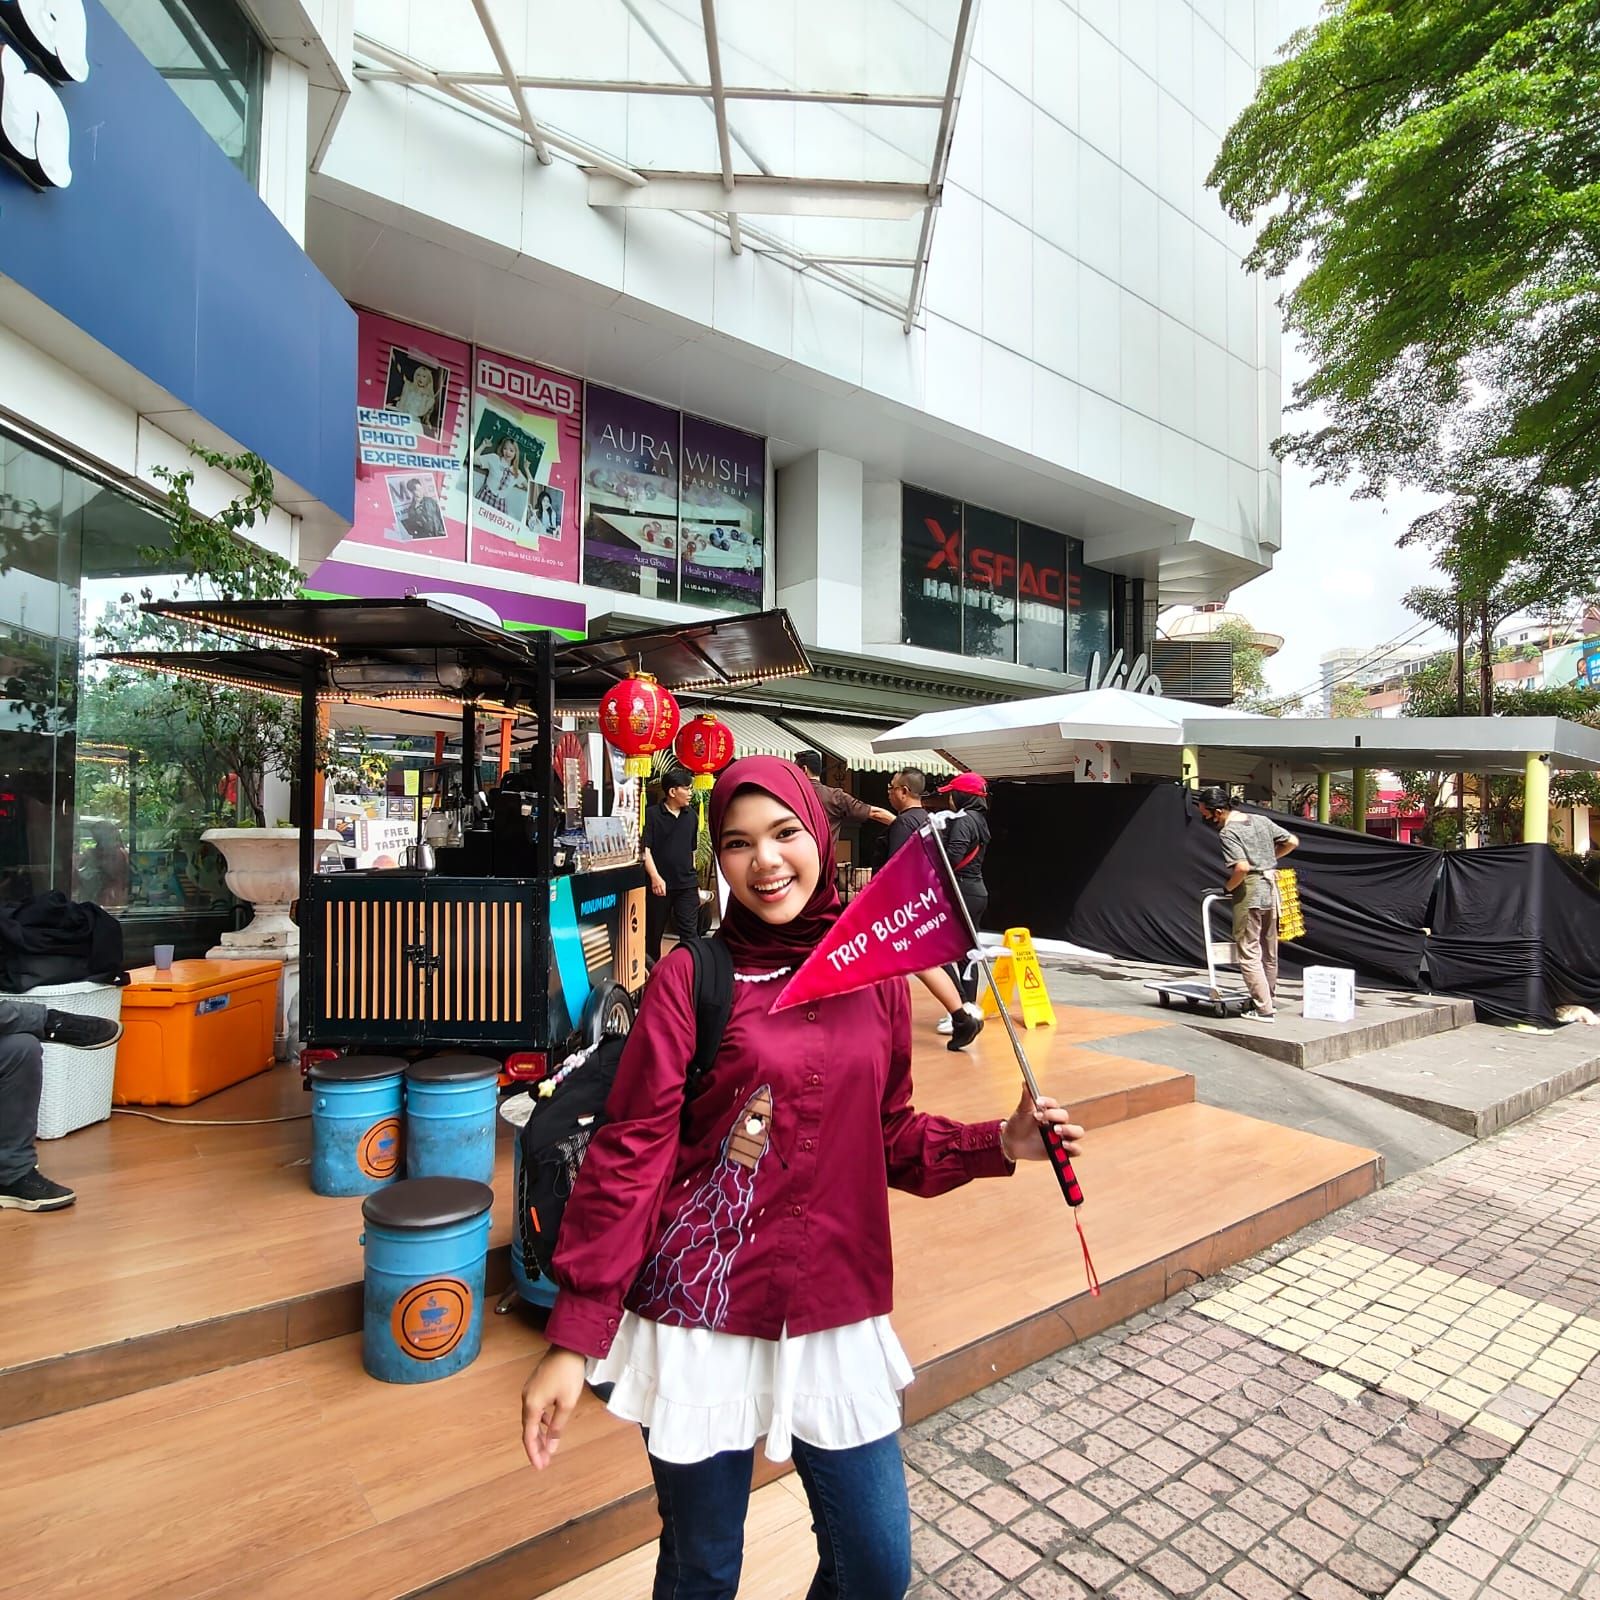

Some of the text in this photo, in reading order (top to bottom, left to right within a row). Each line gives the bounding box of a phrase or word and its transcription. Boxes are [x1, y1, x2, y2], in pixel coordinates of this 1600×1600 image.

[360, 410, 411, 426] K-POP
[362, 430, 416, 447] PHOTO
[364, 450, 461, 471] EXPERIENCE
[599, 423, 750, 487] AURA WISH
[383, 826, 410, 838] FREE
[581, 893, 616, 916] MINUM KOPI
[827, 887, 938, 971] TRIP BLOK-M
[914, 912, 947, 939] nasya
